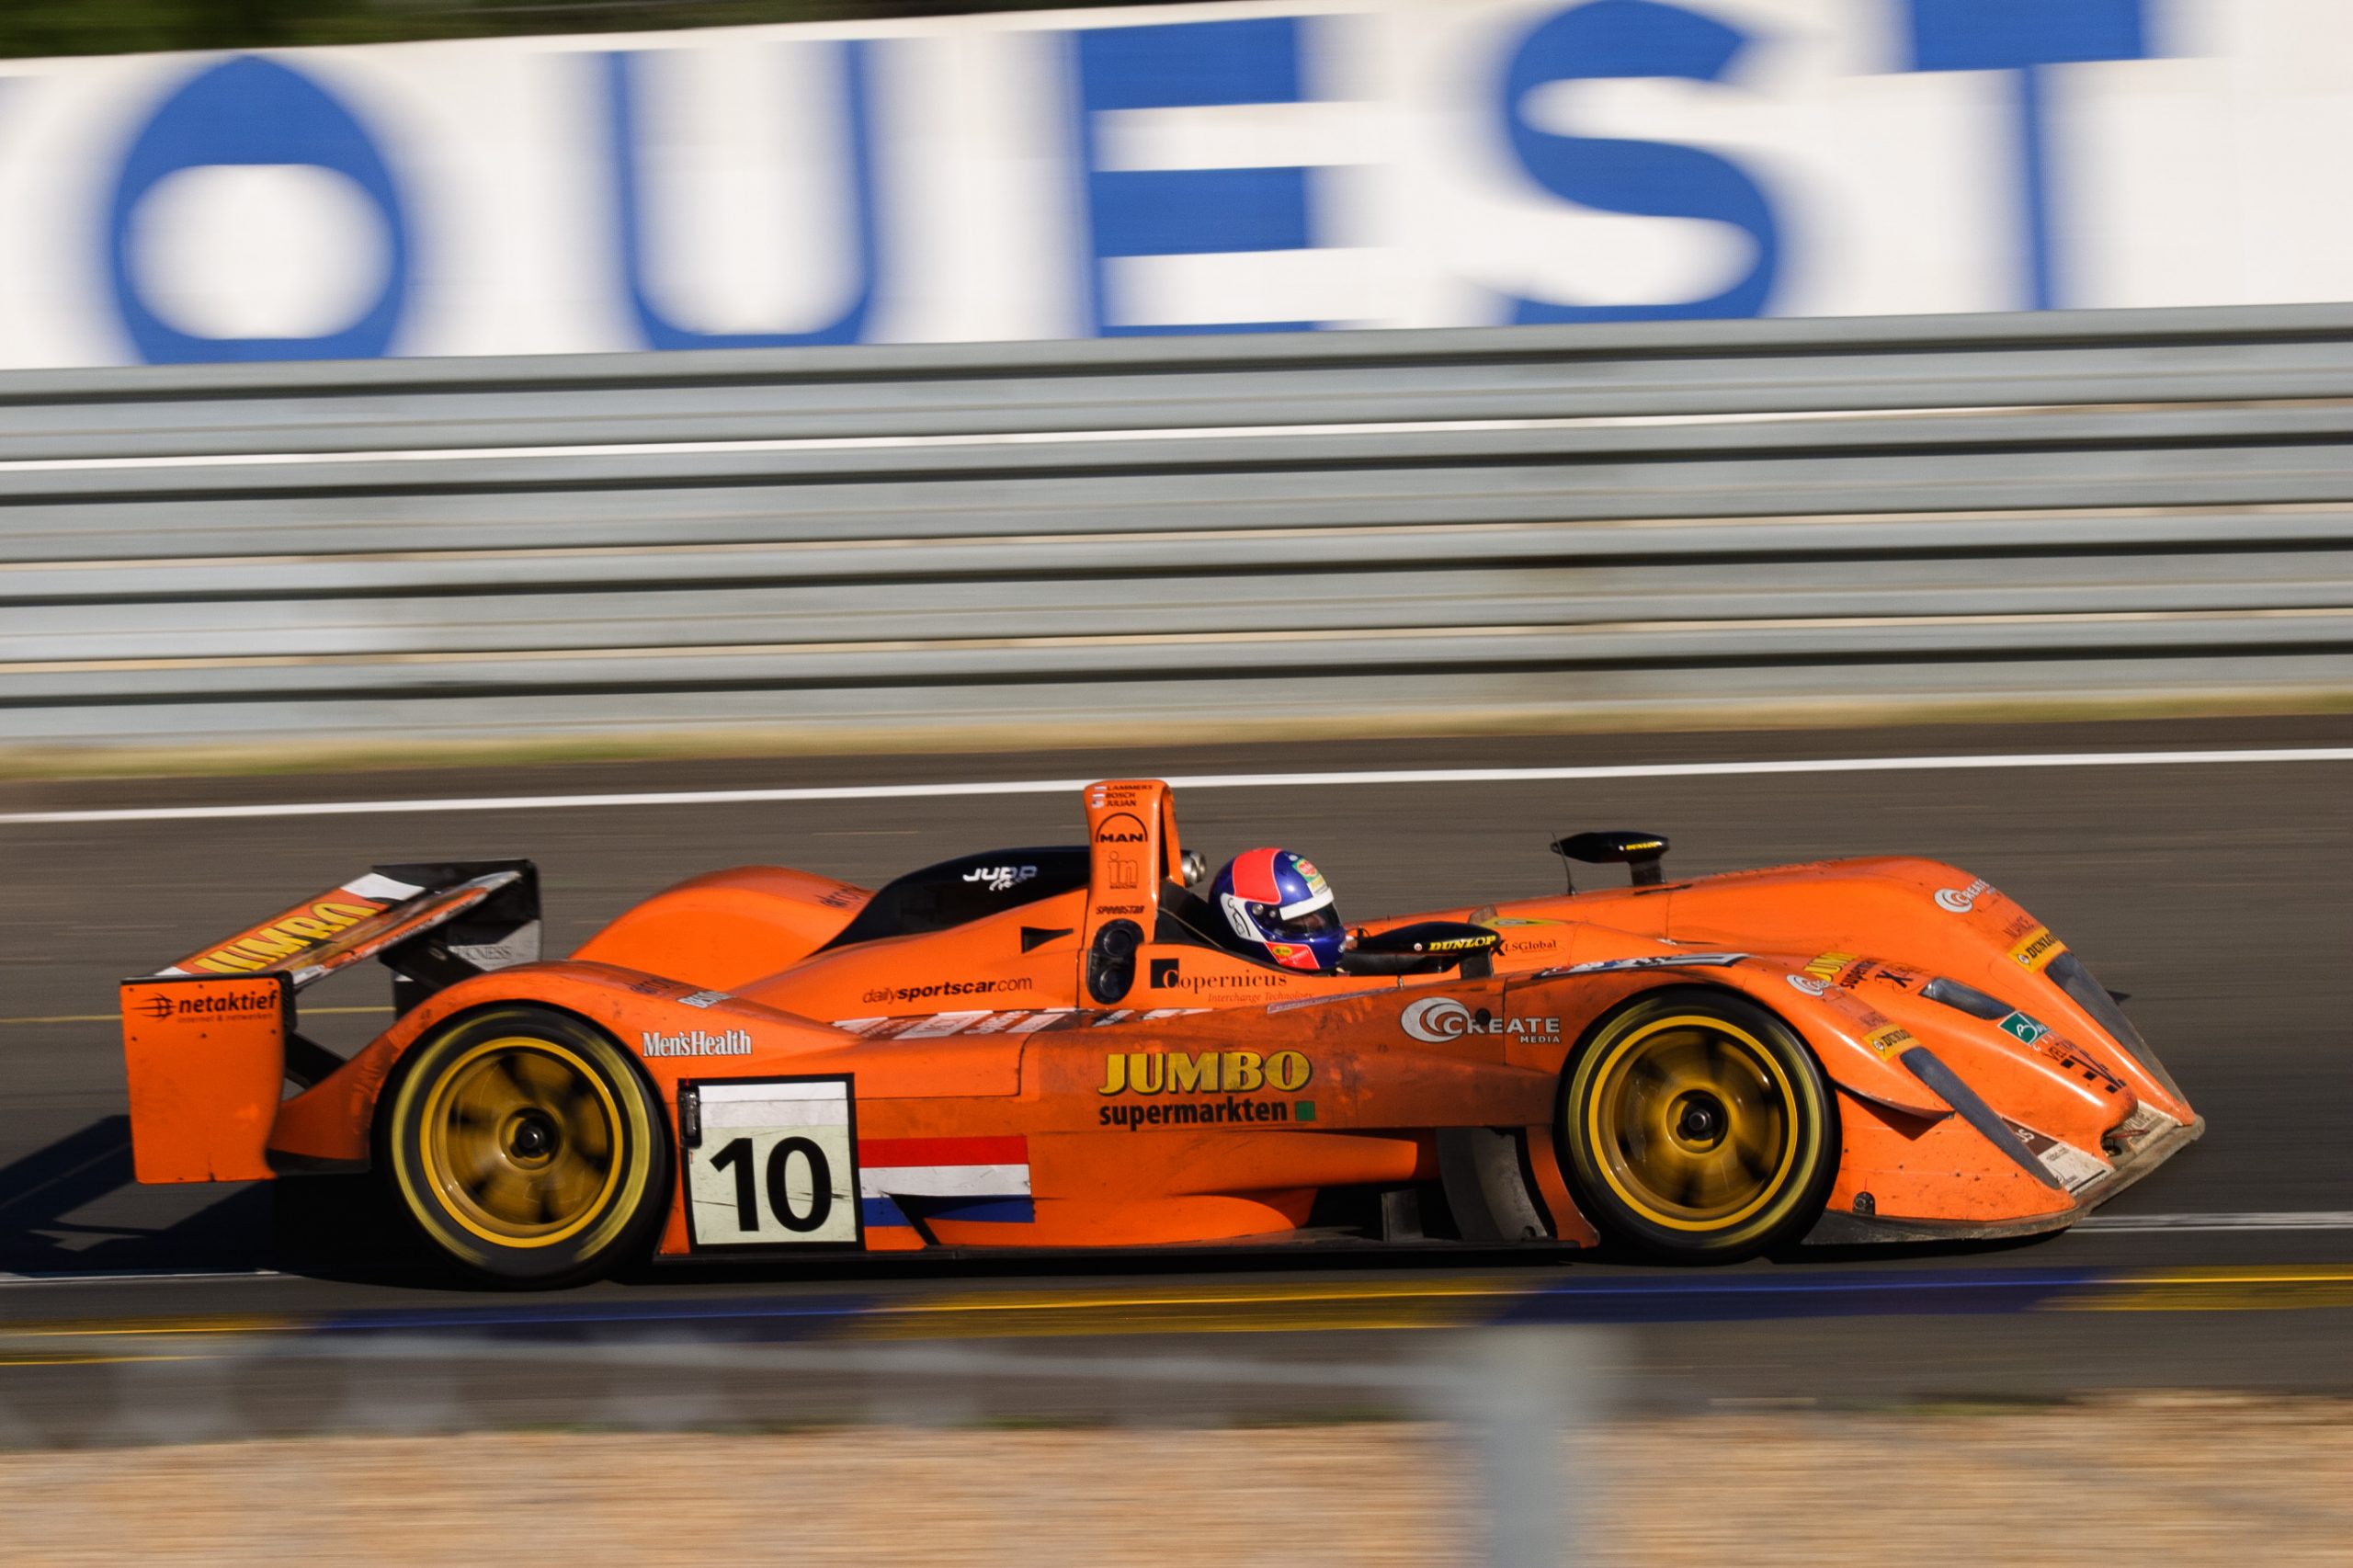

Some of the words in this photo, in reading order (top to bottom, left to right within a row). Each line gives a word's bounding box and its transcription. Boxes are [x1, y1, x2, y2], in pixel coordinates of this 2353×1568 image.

[64, 0, 2224, 366] OUEST
[1099, 833, 1143, 843] MAN
[1108, 850, 1139, 885] in
[1428, 935, 1497, 951] DUNLOP
[862, 976, 1033, 1004] dailysportscar.com
[1163, 969, 1288, 994] Copernicus
[178, 990, 278, 1014] netaktief
[1207, 993, 1261, 1004] Interchange
[1441, 1017, 1561, 1036] CREATE
[1518, 1035, 1561, 1044] MEDIA
[1097, 1050, 1313, 1096] JUMBO
[1098, 1096, 1289, 1132] supermarkten
[709, 1136, 833, 1233] 10
